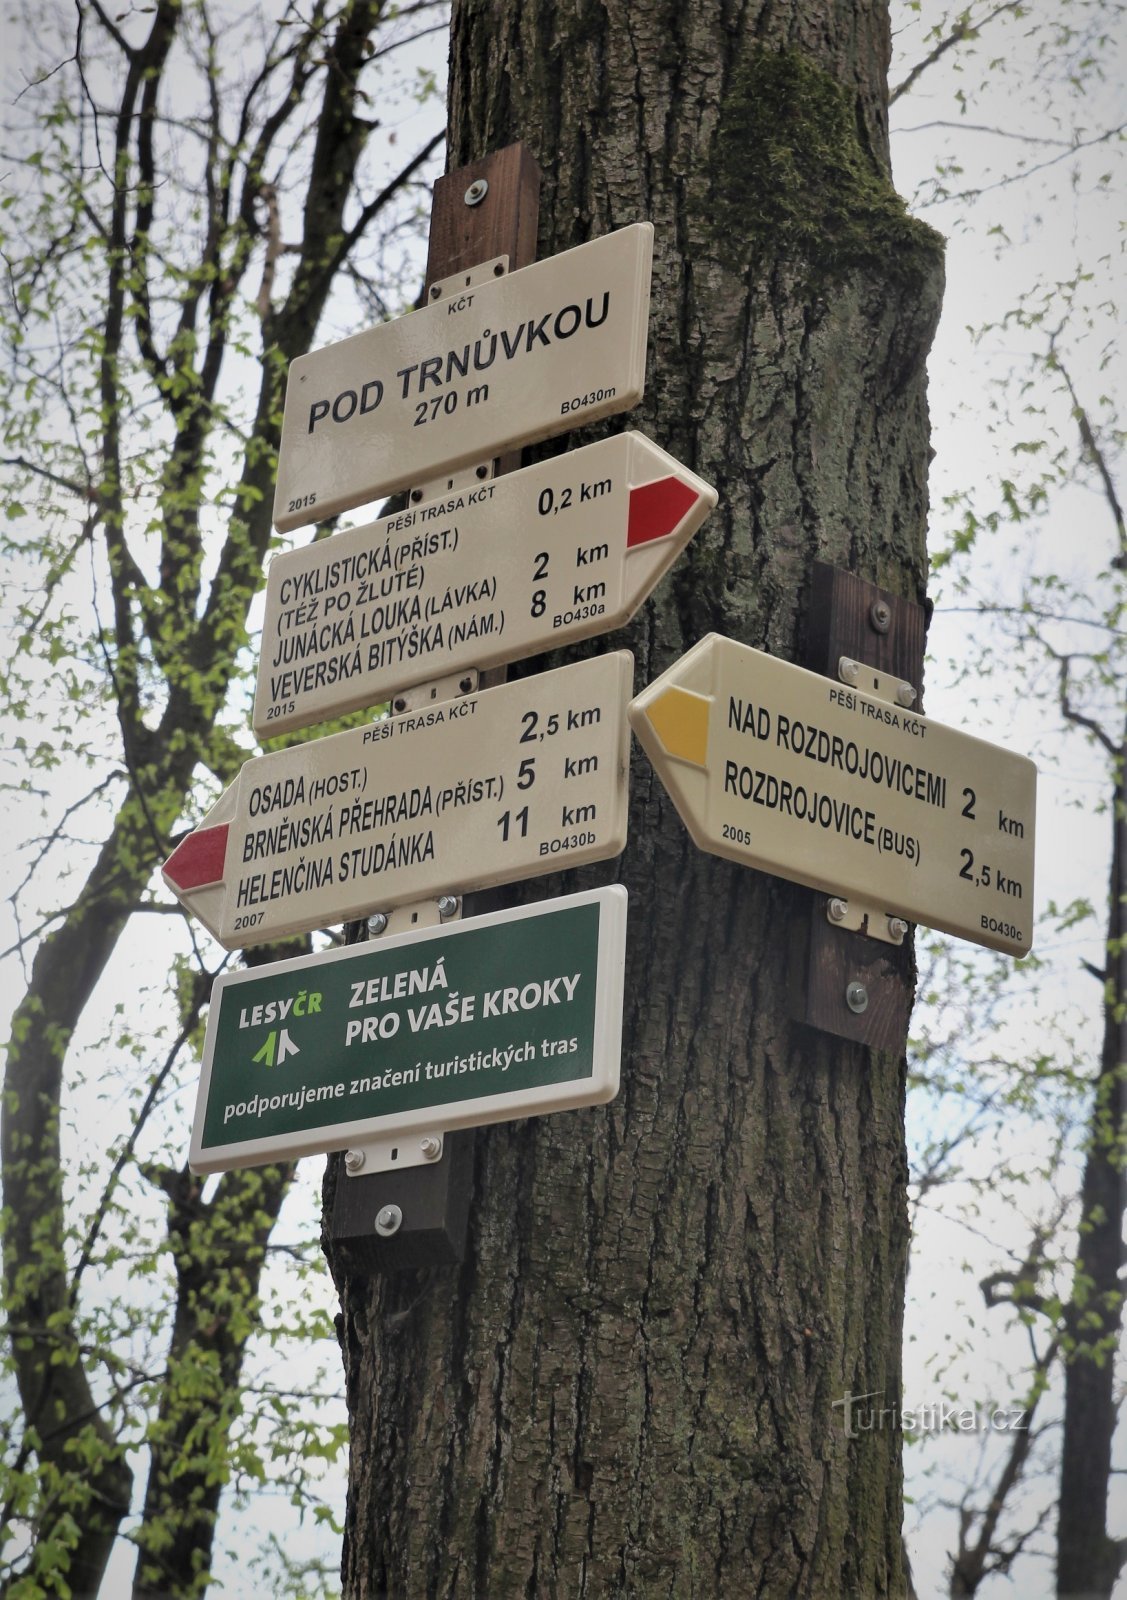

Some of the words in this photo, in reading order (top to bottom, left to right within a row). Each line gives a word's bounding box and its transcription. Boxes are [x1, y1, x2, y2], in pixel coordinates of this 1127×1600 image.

[448, 295, 474, 314] KČT
[308, 380, 383, 433] POD
[397, 292, 609, 400] TRNŮVKOU
[413, 391, 458, 426] 270
[467, 384, 489, 407] m
[561, 387, 616, 415] BO430m
[289, 493, 316, 512] 2015
[386, 511, 417, 534] PĚŠÍ
[421, 499, 465, 526] TRASA
[468, 486, 495, 513] KČT
[280, 539, 391, 605] CYKLISTICKÁ
[394, 527, 458, 569] (PŘÍST.)
[538, 488, 572, 515] 0,2
[580, 478, 611, 502] km
[273, 612, 354, 666] JUNÁCKÁ
[361, 595, 421, 638] LOUKA
[425, 576, 497, 622] (LÁVKA)
[533, 553, 549, 581] 2
[577, 542, 608, 567] km
[278, 602, 318, 636] (TÉŽ
[325, 591, 352, 619] PO
[355, 565, 425, 606] ŽLUTÉ)
[553, 602, 605, 629] BO430a
[270, 645, 362, 701] VEVERSKÁ
[368, 625, 443, 672] BITÝŠKA
[448, 610, 504, 651] (NÁM.)
[531, 590, 546, 617] 8
[574, 581, 605, 604] km
[267, 701, 295, 719] 2015
[363, 722, 394, 744] PĚŠÍ
[398, 711, 445, 737] TRASA
[449, 701, 478, 725] KČT
[830, 689, 857, 712] PĚŠÍ
[860, 701, 900, 728] TRASA
[903, 714, 927, 738] KČT
[249, 776, 305, 817] OSADA
[309, 767, 367, 803] (HOST.)
[520, 711, 559, 743] 2,5
[567, 707, 601, 730] km
[728, 697, 770, 741] NAD
[777, 715, 946, 808] ROZDROJOVICEMI
[962, 788, 976, 820] 2
[999, 810, 1024, 839] km
[243, 805, 333, 863] BRNĚNSKÁ
[340, 785, 432, 838] PŘEHRADA
[436, 775, 504, 818] (PŘÍST.)
[517, 758, 535, 789] 5
[565, 755, 598, 779] km
[237, 857, 333, 908] HELENČINA
[339, 830, 434, 882] STUDÁNKA
[497, 806, 529, 842] 11
[562, 804, 596, 828] km
[539, 831, 596, 857] BO430b
[722, 824, 751, 846] 2005
[959, 848, 991, 887] 2,5
[997, 870, 1022, 899] km
[234, 912, 264, 931] 2007
[980, 915, 1022, 941] BO430c
[349, 956, 448, 1008] ZELENÁ
[345, 1012, 399, 1046] PRO
[407, 991, 475, 1035] VAŠE
[483, 973, 581, 1019] KROKY
[223, 1081, 345, 1124] podporujeme
[349, 1063, 420, 1095] značení
[425, 1042, 535, 1080] turistických
[541, 1036, 578, 1059] tras
